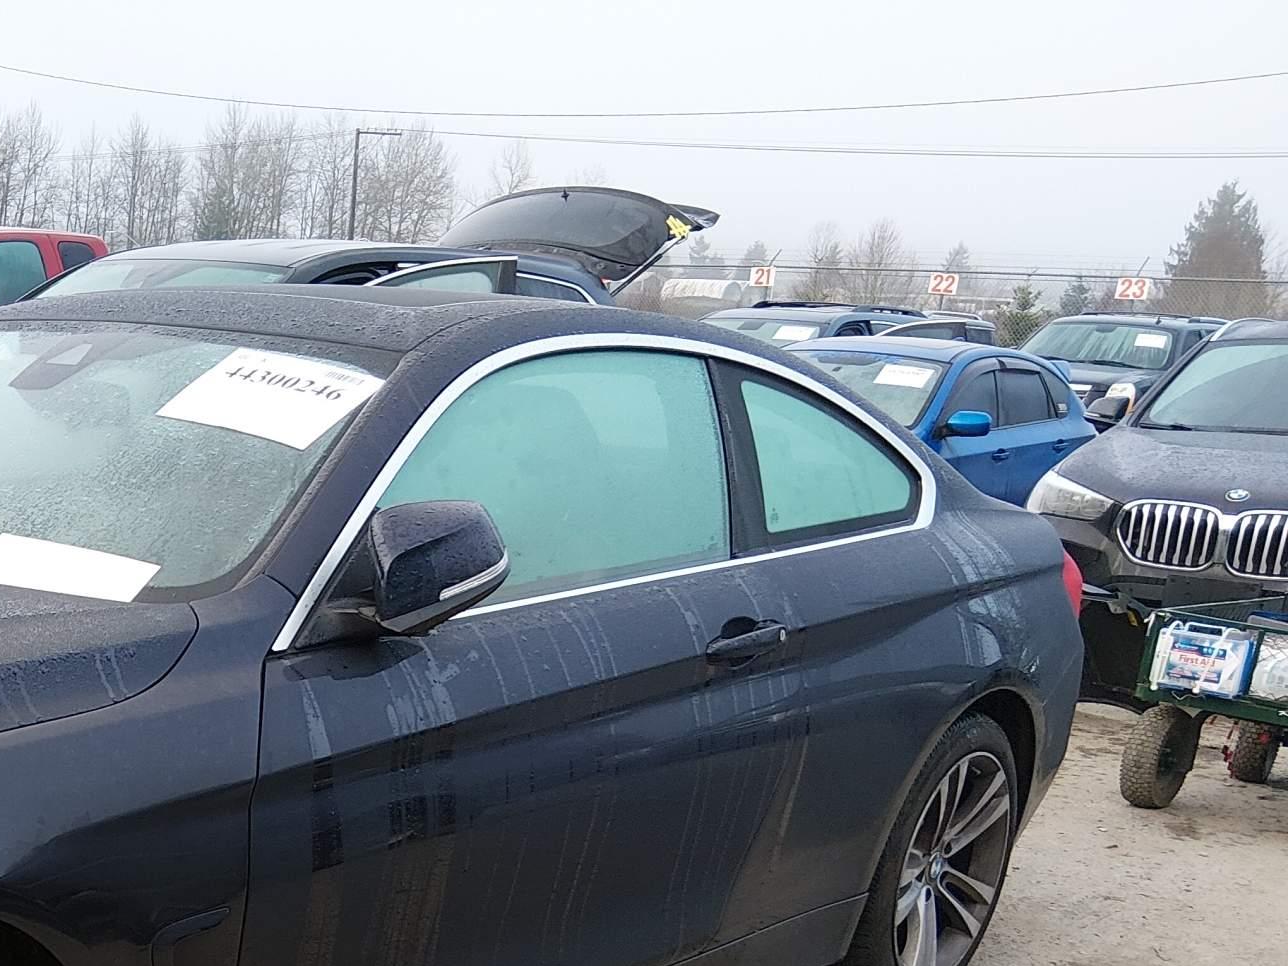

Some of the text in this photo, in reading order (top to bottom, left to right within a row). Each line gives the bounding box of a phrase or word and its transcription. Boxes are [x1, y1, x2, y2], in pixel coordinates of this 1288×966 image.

[754, 268, 771, 285] 21
[931, 274, 955, 293] 22
[1118, 279, 1146, 298] 23
[225, 366, 345, 401] 44300246
[1179, 654, 1199, 665] First
